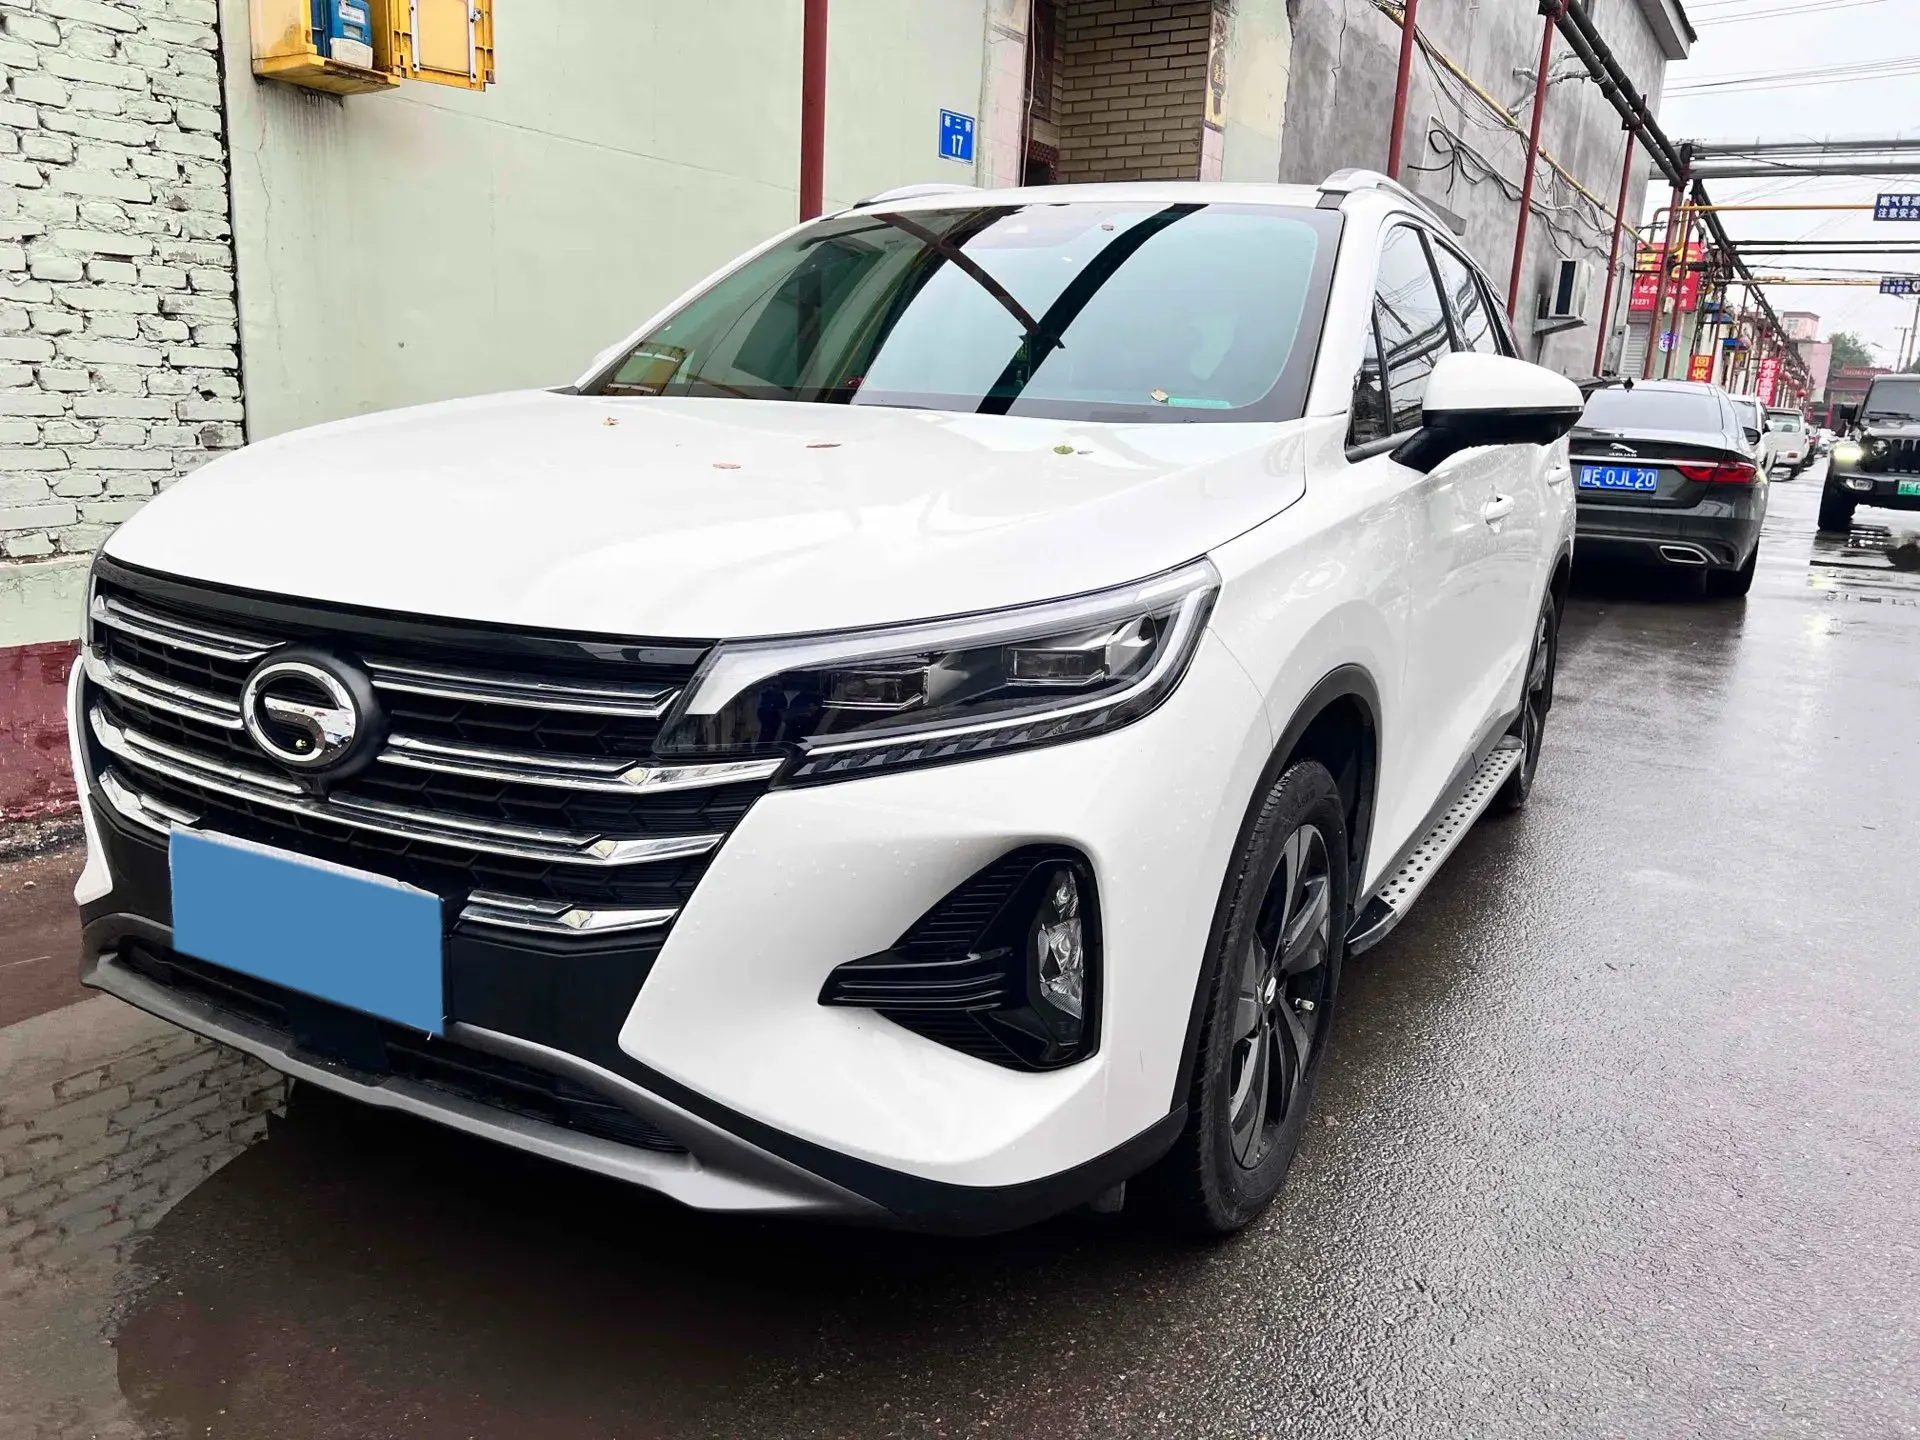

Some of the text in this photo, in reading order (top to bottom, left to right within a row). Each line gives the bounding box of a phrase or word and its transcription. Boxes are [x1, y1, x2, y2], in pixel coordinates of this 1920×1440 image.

[951, 134, 963, 155] 17
[1878, 208, 1919, 218] 注意安全
[1692, 356, 1710, 383] 回收
